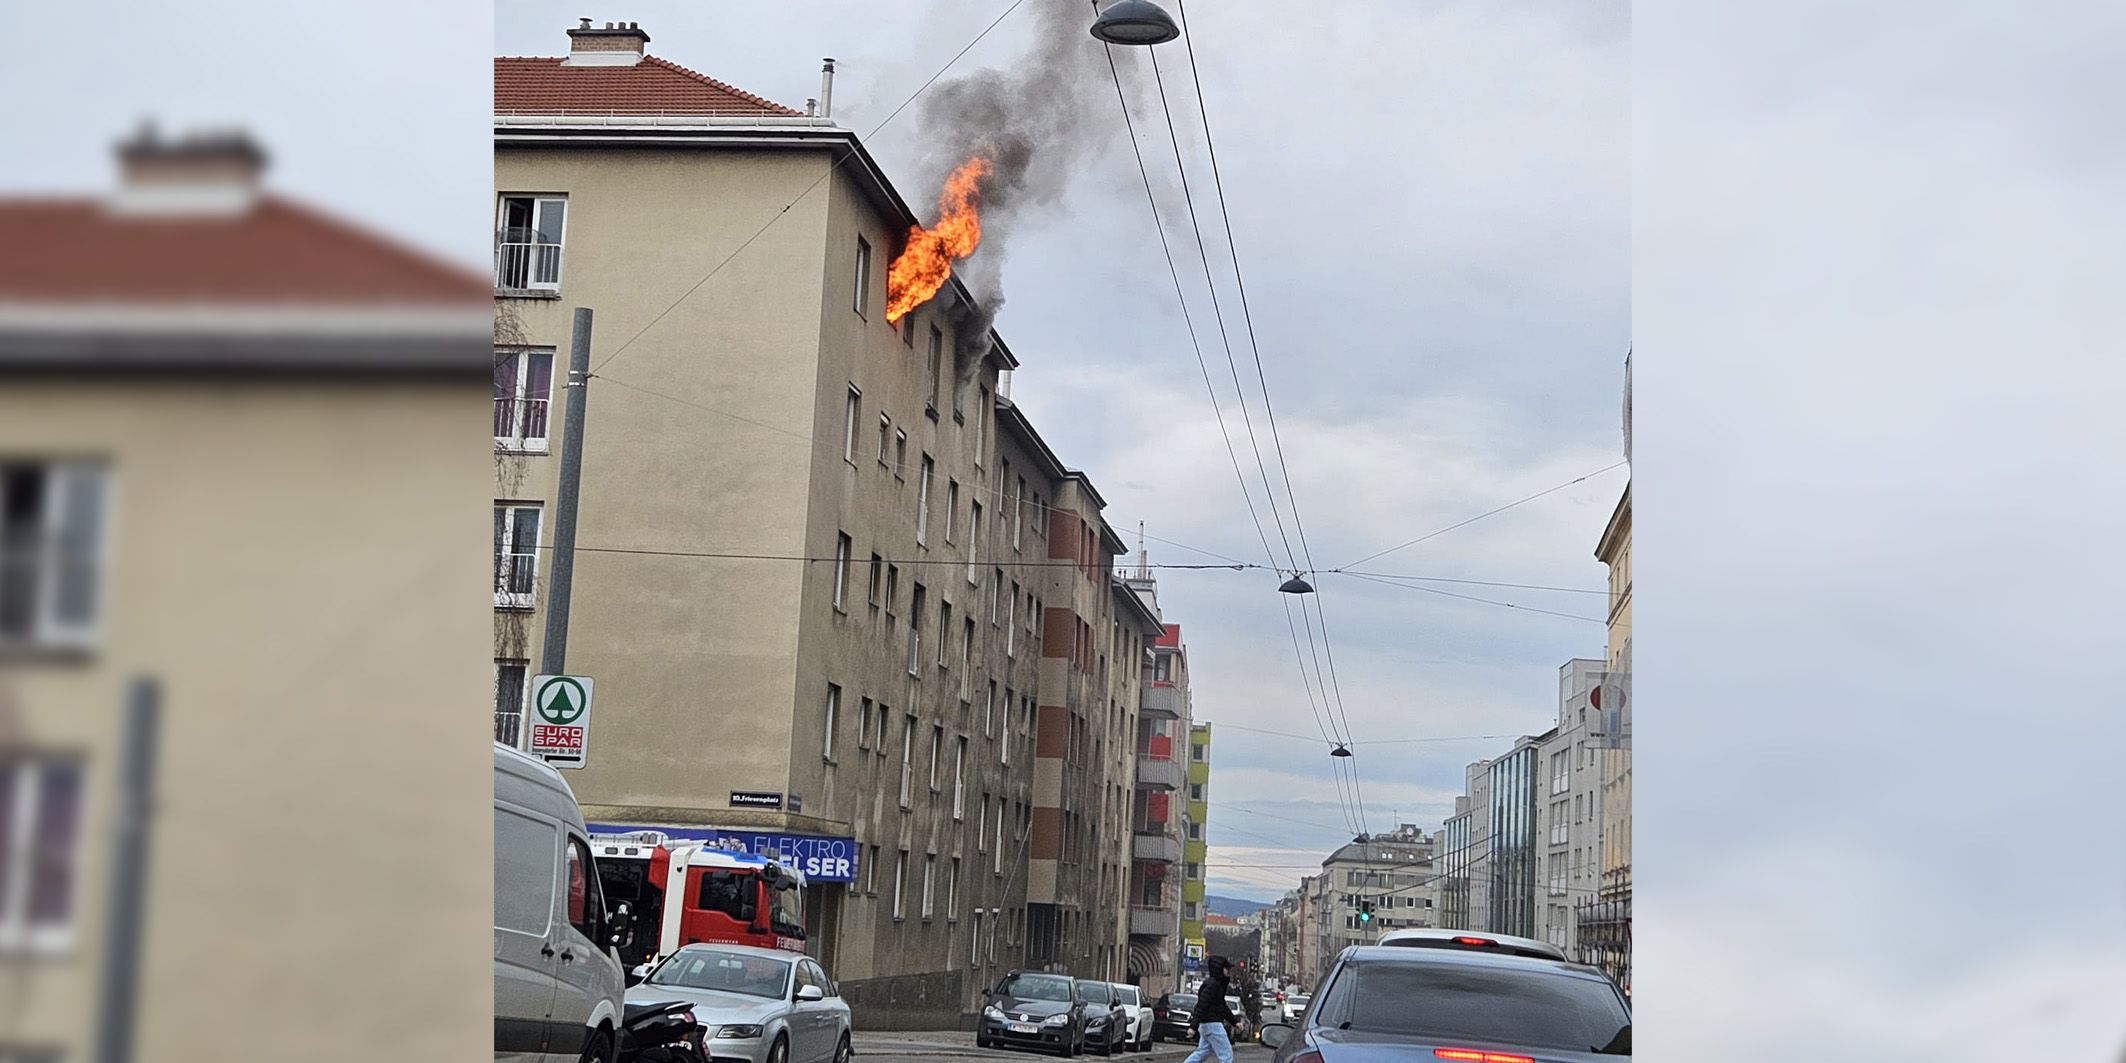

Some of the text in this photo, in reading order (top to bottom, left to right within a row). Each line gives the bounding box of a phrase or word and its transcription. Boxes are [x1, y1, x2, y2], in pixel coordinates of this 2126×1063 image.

[535, 727, 582, 737] EURO
[534, 736, 581, 746] SPAR
[778, 855, 850, 877] ELSER
